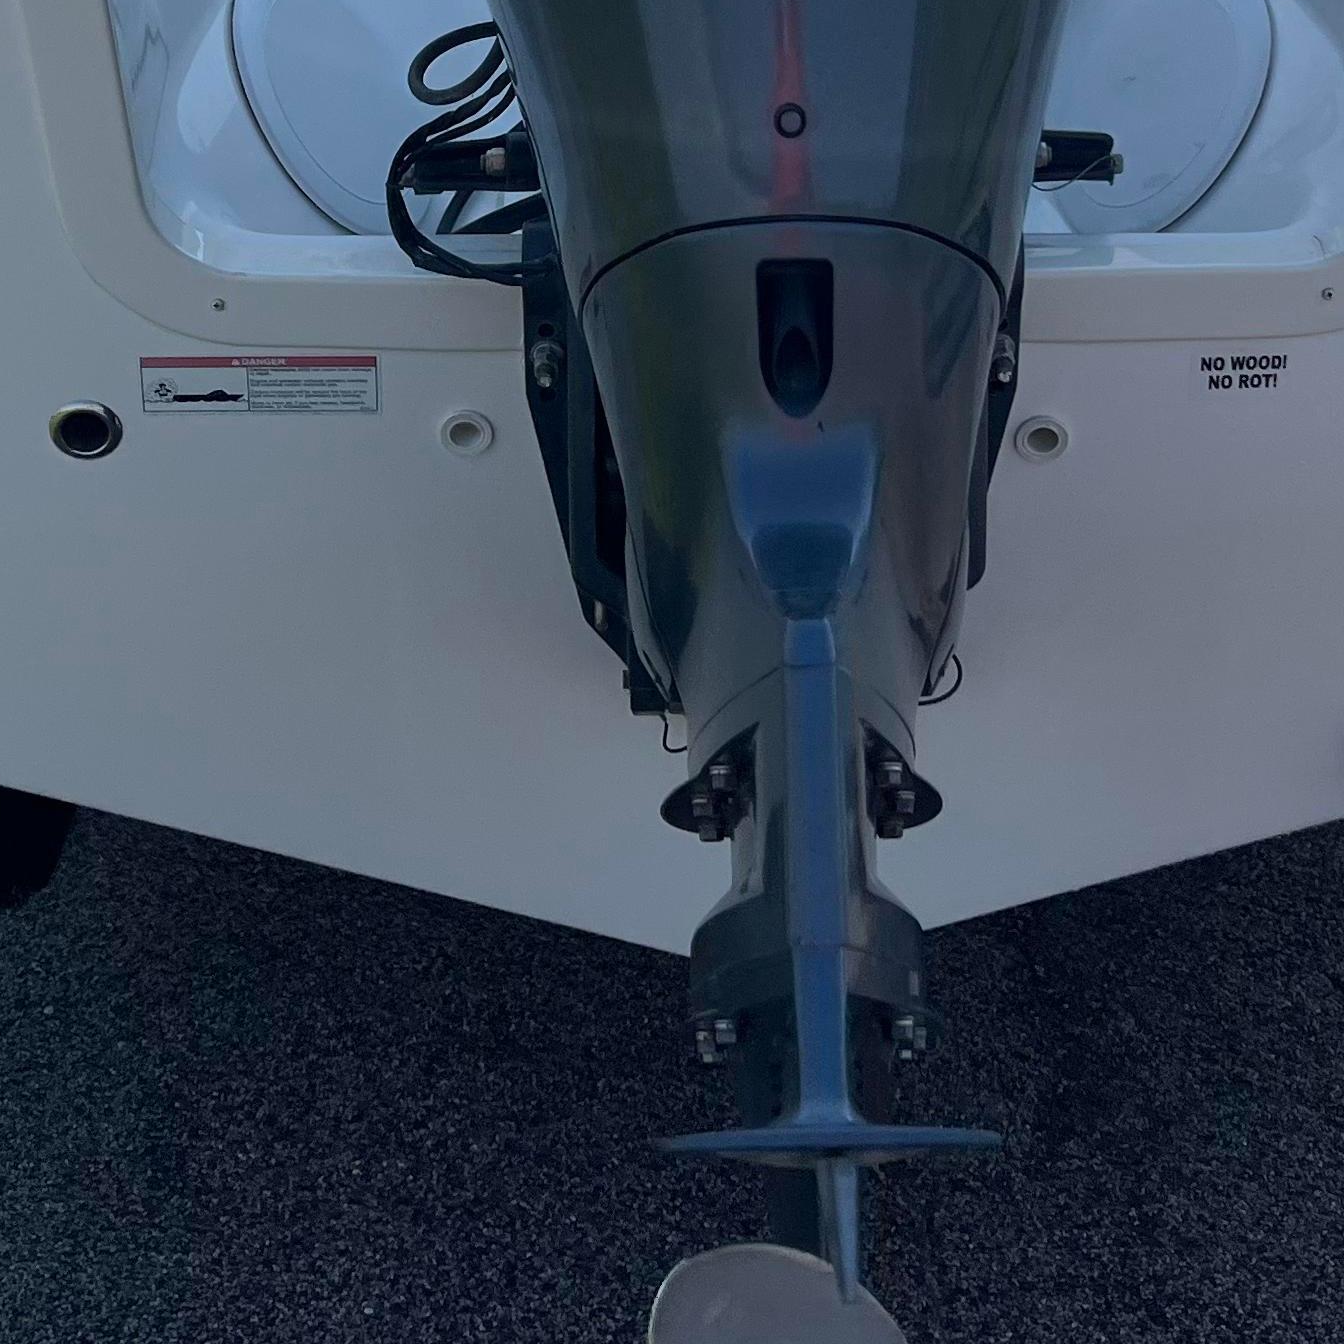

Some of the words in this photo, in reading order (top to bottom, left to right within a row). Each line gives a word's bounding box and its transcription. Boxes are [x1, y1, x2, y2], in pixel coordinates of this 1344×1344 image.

[241, 358, 288, 367] DANGER
[1200, 357, 1226, 372] NO
[1230, 355, 1288, 371] WOOD!
[1208, 374, 1233, 390] NO
[1238, 373, 1278, 389] ROT!
